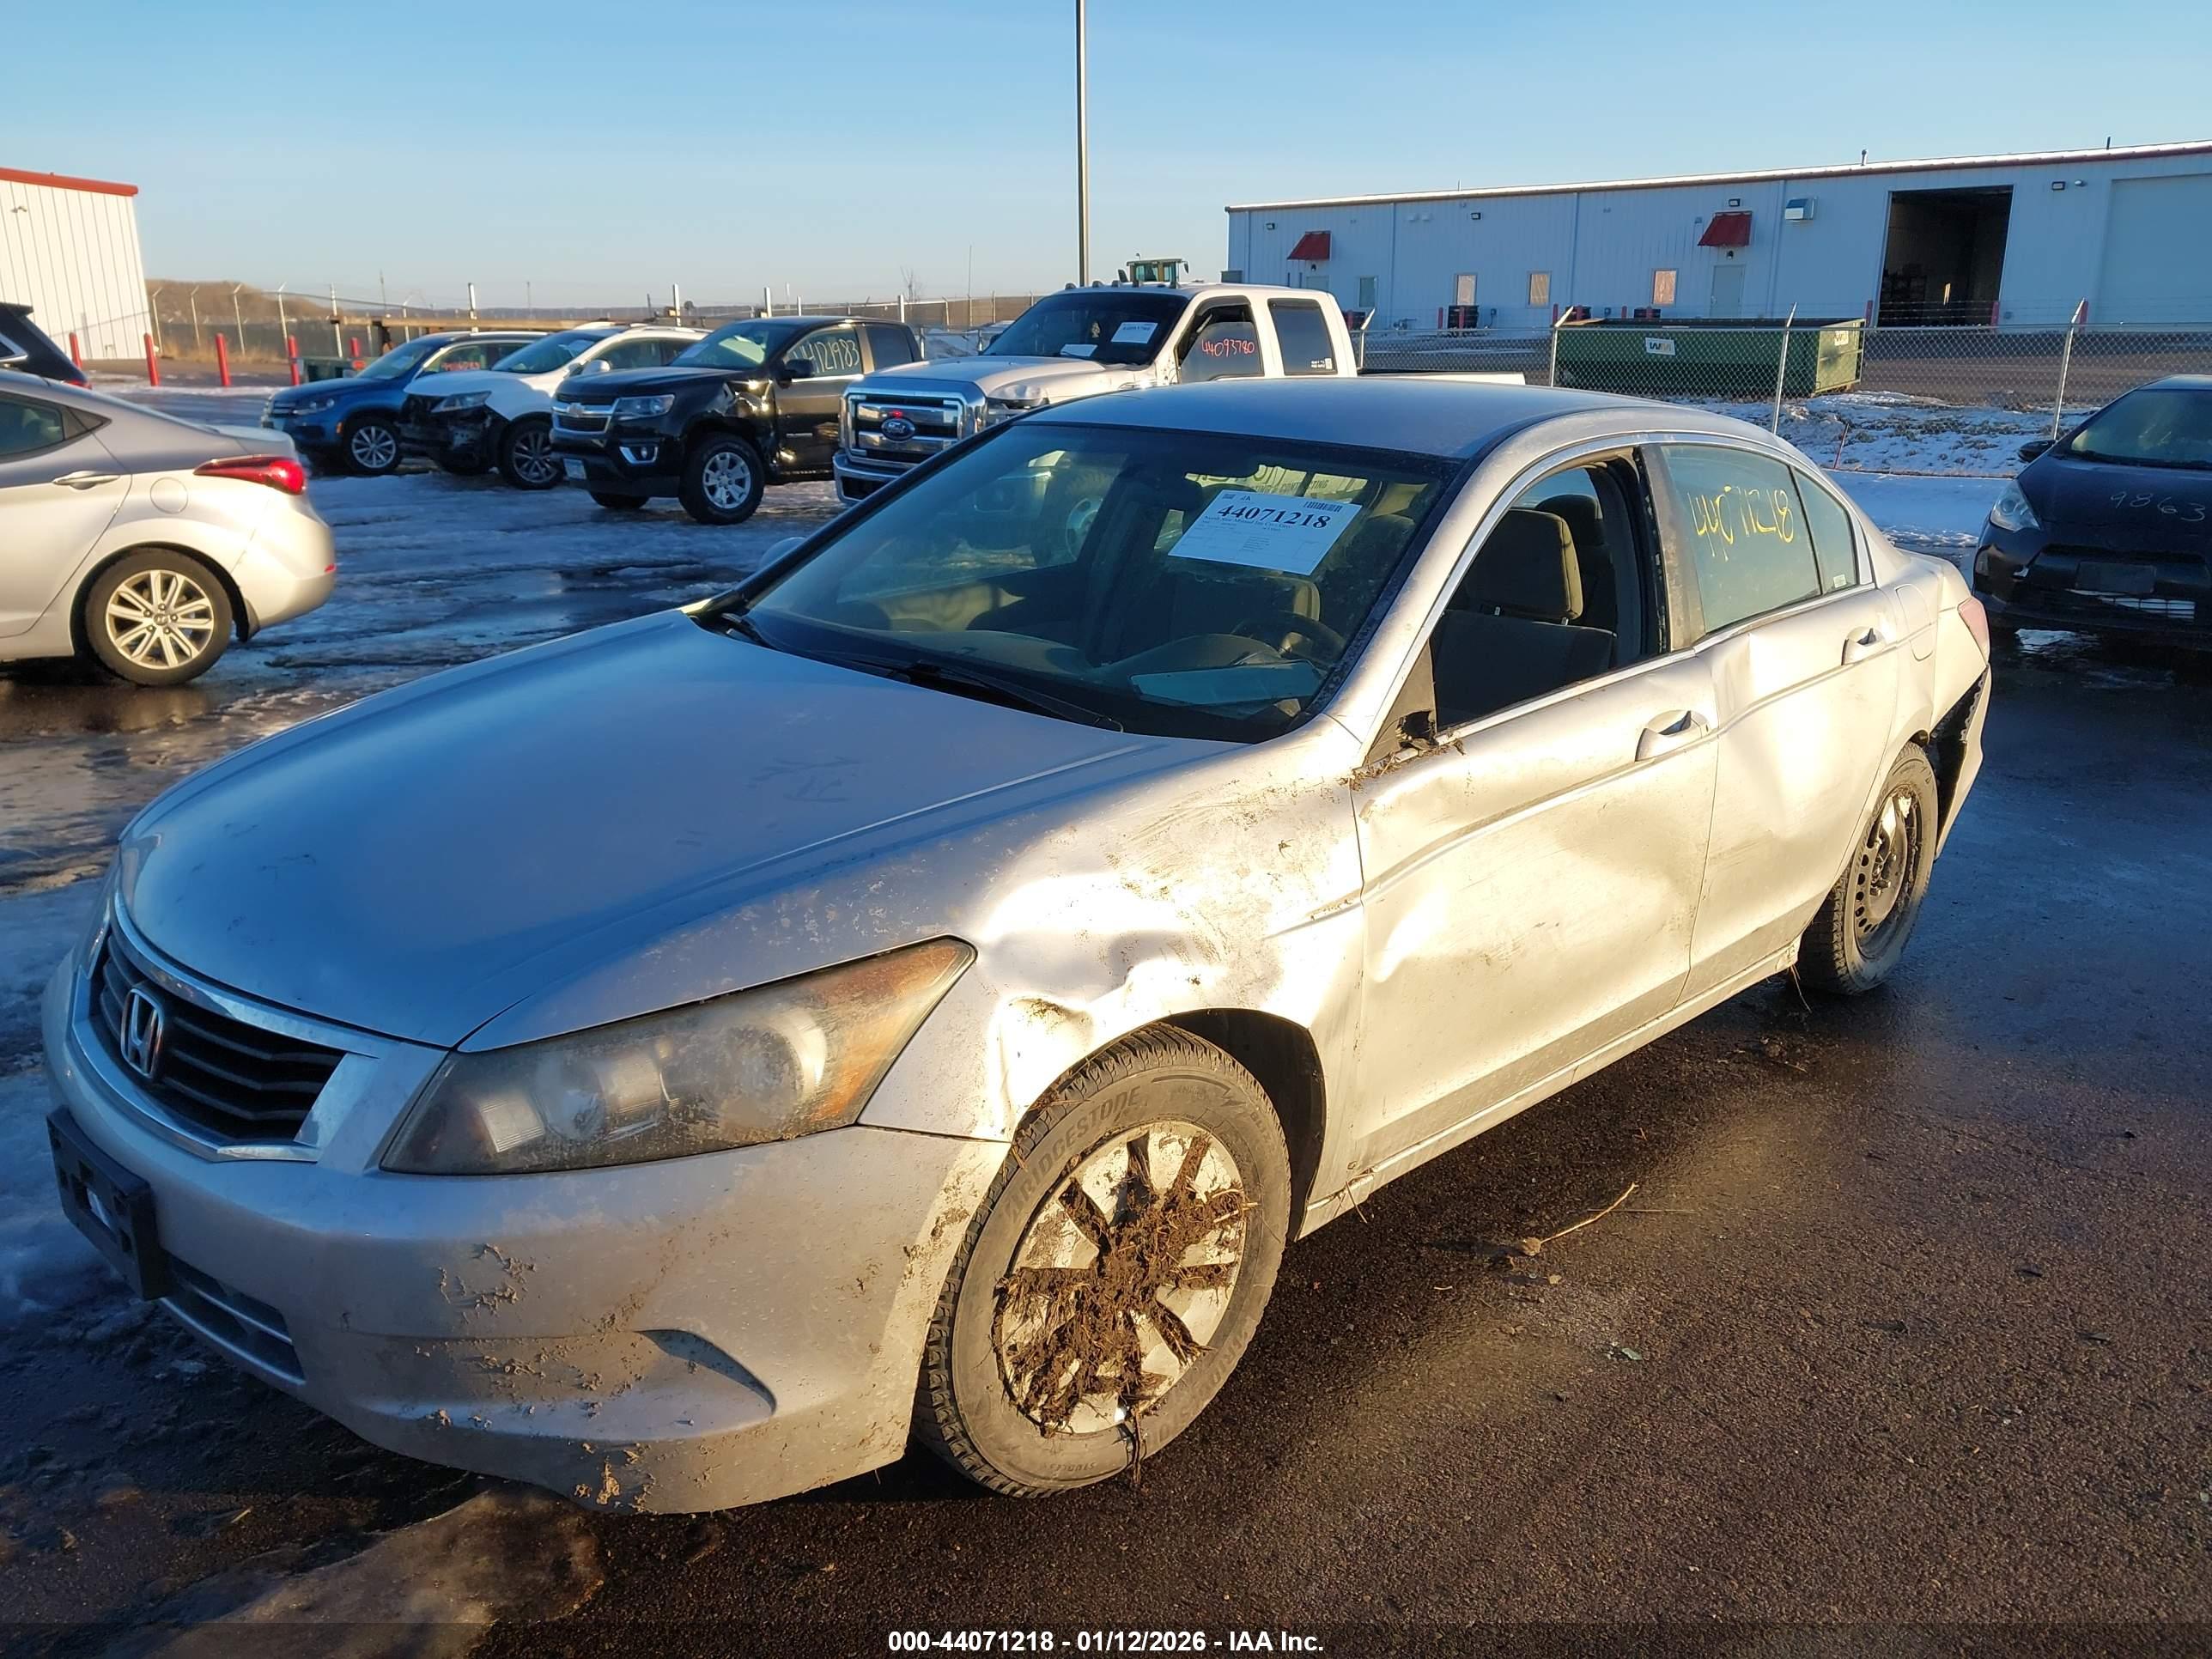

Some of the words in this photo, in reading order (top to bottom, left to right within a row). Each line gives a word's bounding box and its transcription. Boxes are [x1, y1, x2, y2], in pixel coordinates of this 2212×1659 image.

[1202, 338, 1255, 357] 44093780
[1218, 504, 1331, 529] 44071218
[1687, 485, 1794, 562] 44071218
